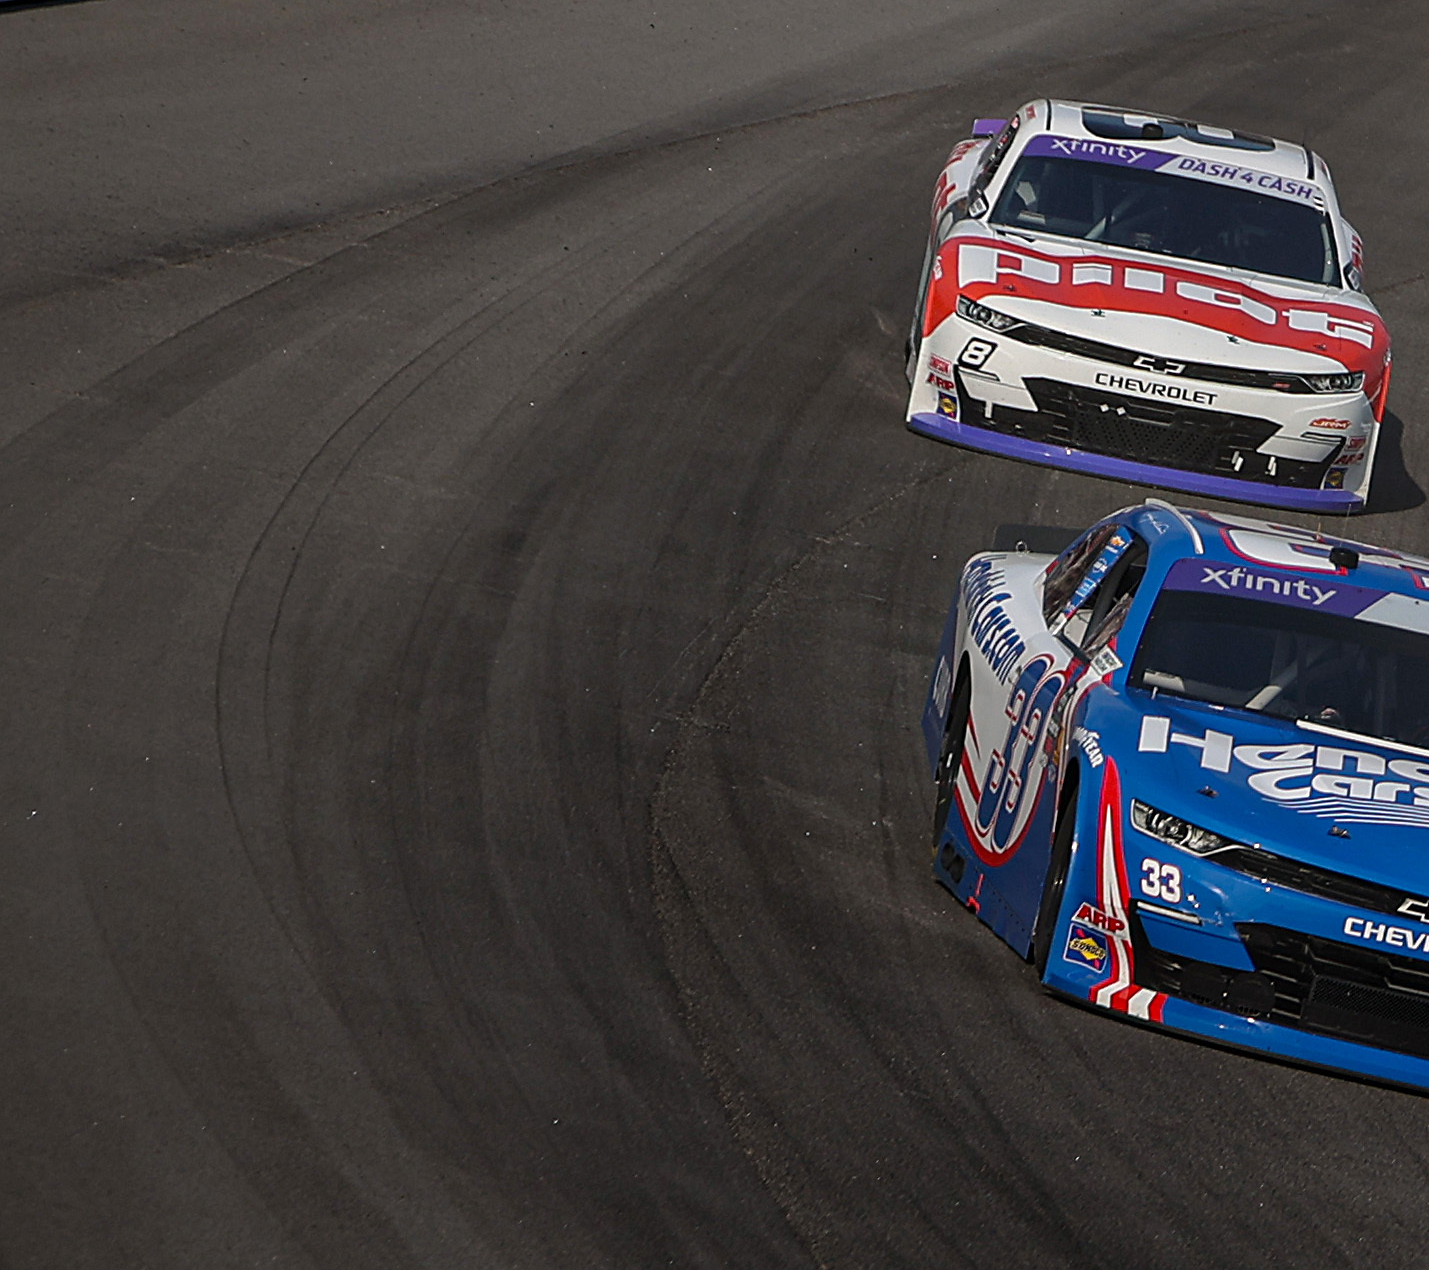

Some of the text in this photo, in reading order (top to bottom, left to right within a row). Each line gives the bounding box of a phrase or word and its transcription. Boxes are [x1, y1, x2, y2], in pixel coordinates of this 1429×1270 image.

[1050, 137, 1147, 163] xfinity
[1177, 156, 1314, 202] DASH 4 CASH
[960, 339, 994, 367] 8
[1094, 372, 1219, 406] CHEVROLET
[1200, 564, 1338, 606] xfinity
[1140, 857, 1182, 904] 33
[1076, 904, 1126, 934] ARP
